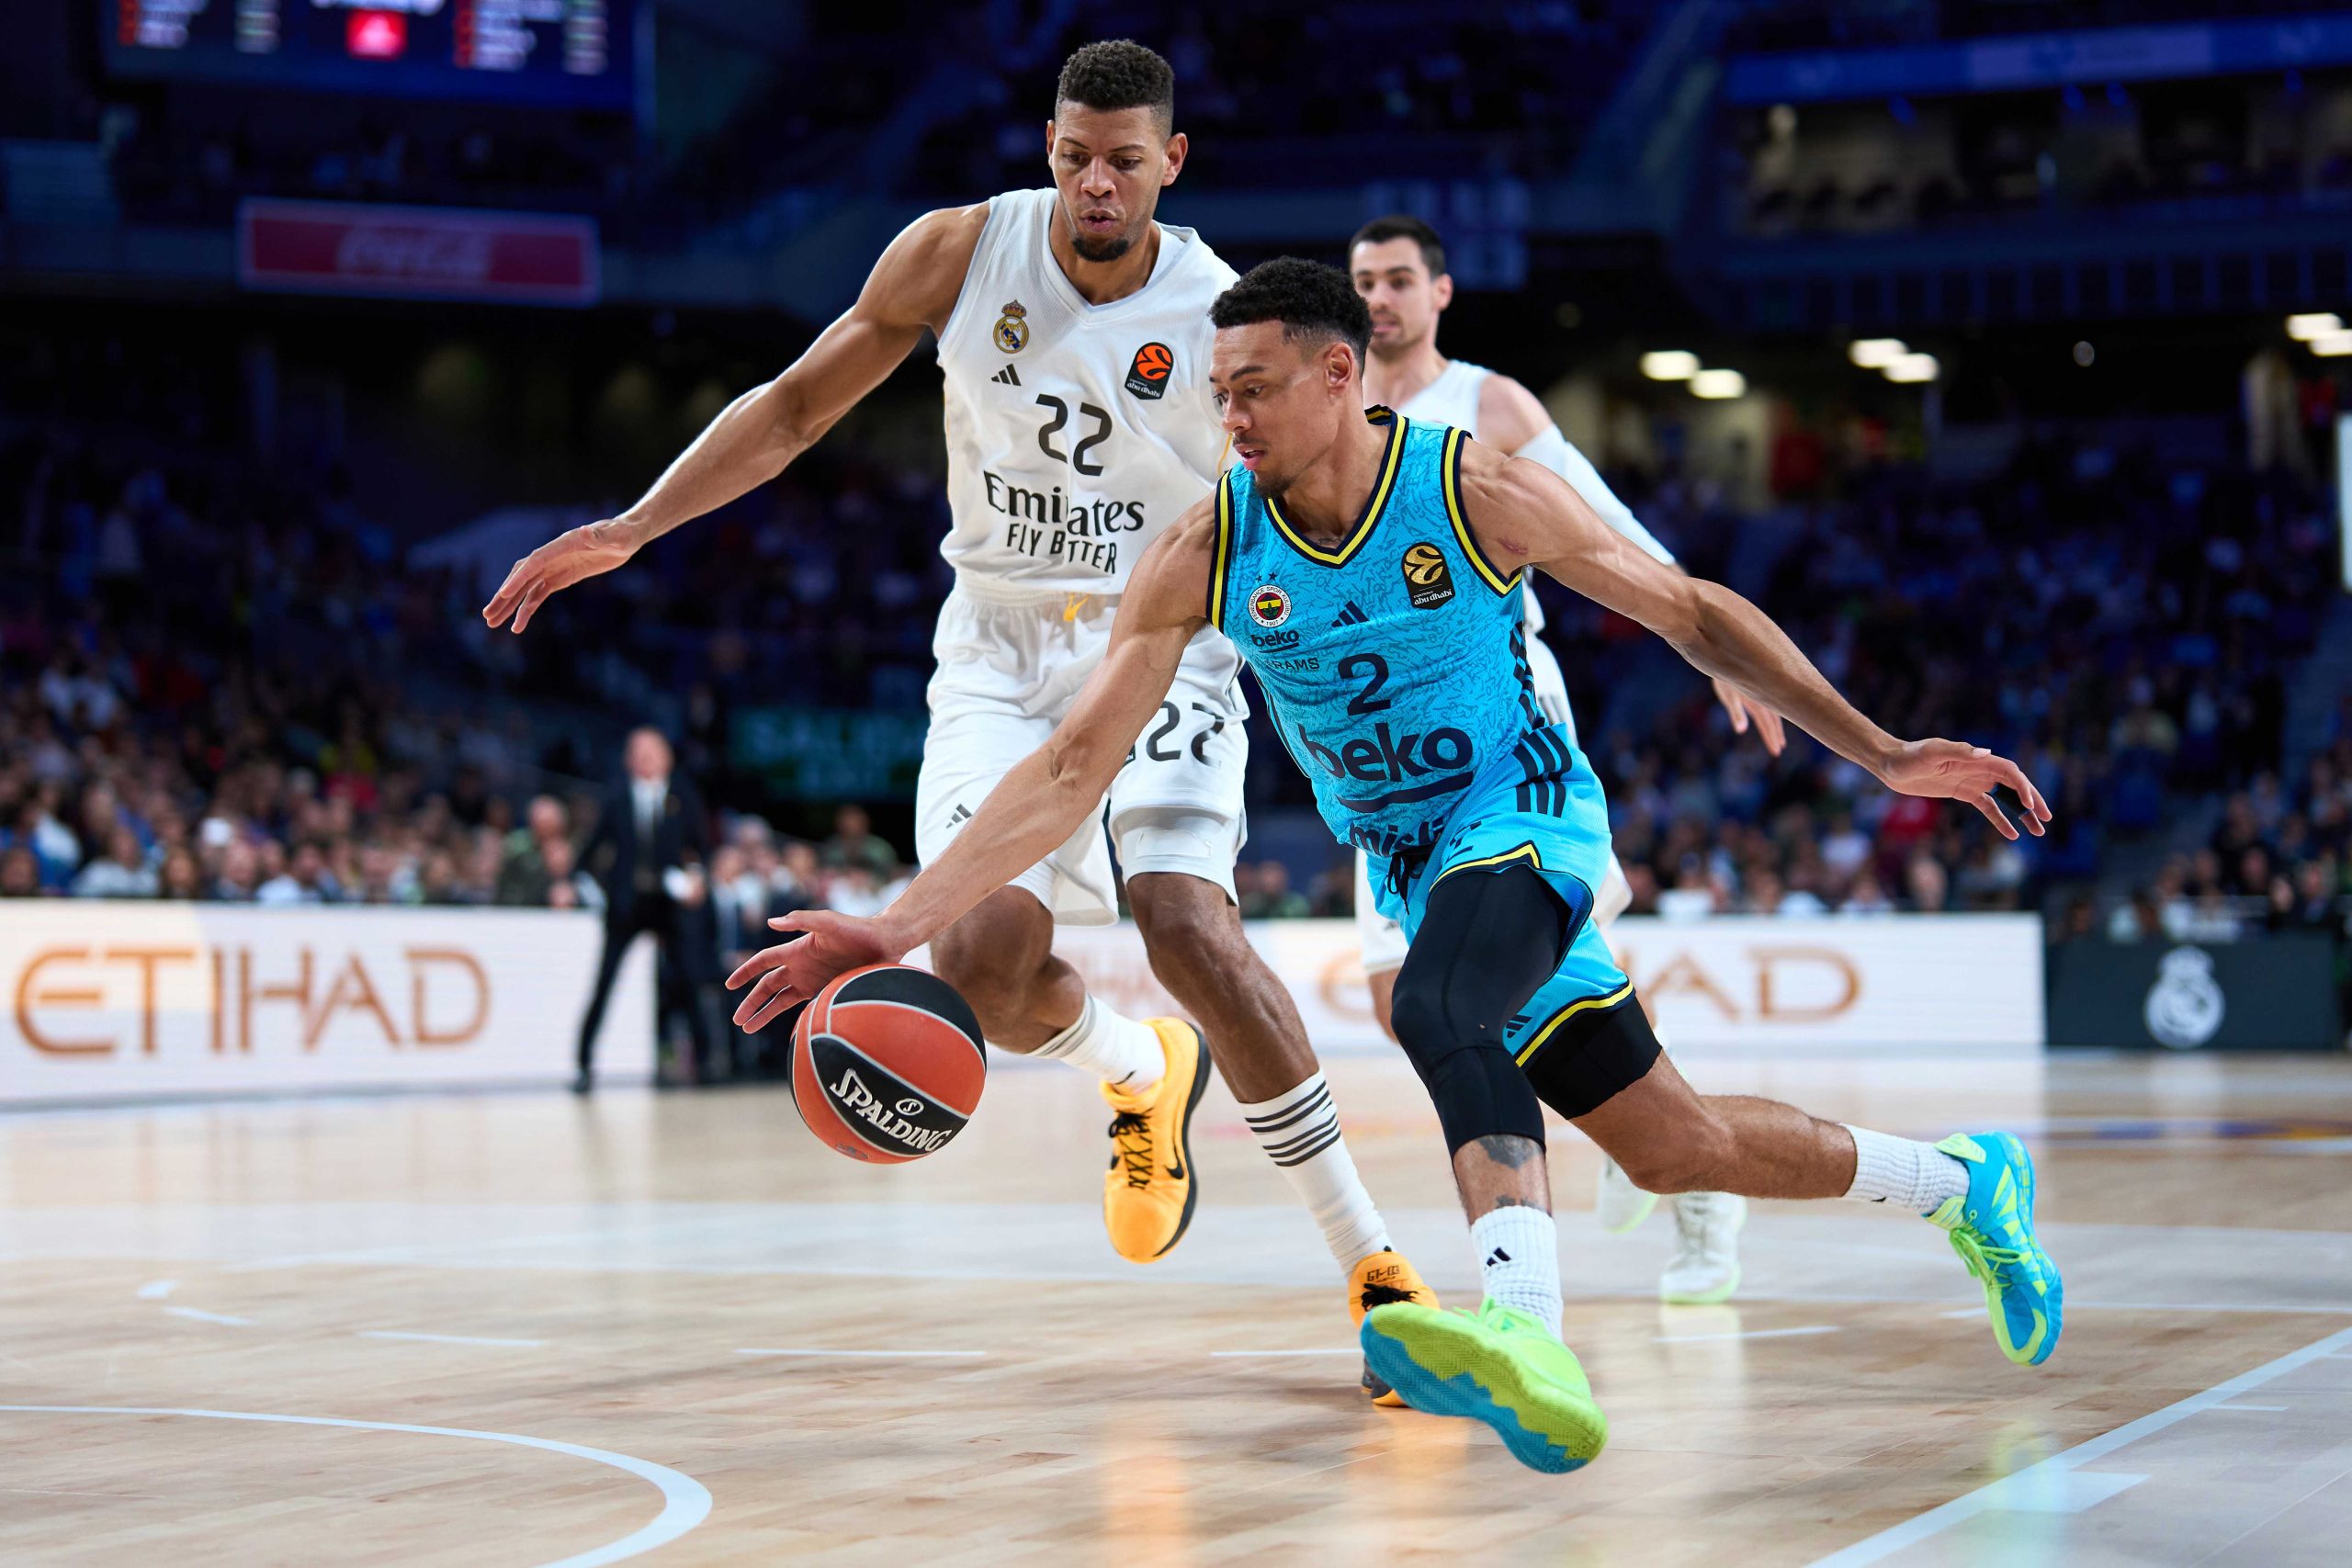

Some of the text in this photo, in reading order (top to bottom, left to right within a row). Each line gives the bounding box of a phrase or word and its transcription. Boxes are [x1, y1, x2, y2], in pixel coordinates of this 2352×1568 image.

[1035, 393, 1113, 477] 22
[983, 470, 1145, 536] Emiates
[1007, 523, 1043, 557] FLY
[1414, 596, 1430, 605] abu
[1430, 589, 1453, 601] dhabi
[1250, 630, 1300, 648] beko
[1338, 652, 1392, 716] 2
[1297, 722, 1474, 783] beko
[14, 945, 494, 1055] ETIHAD
[830, 1067, 953, 1153] SPALDING
